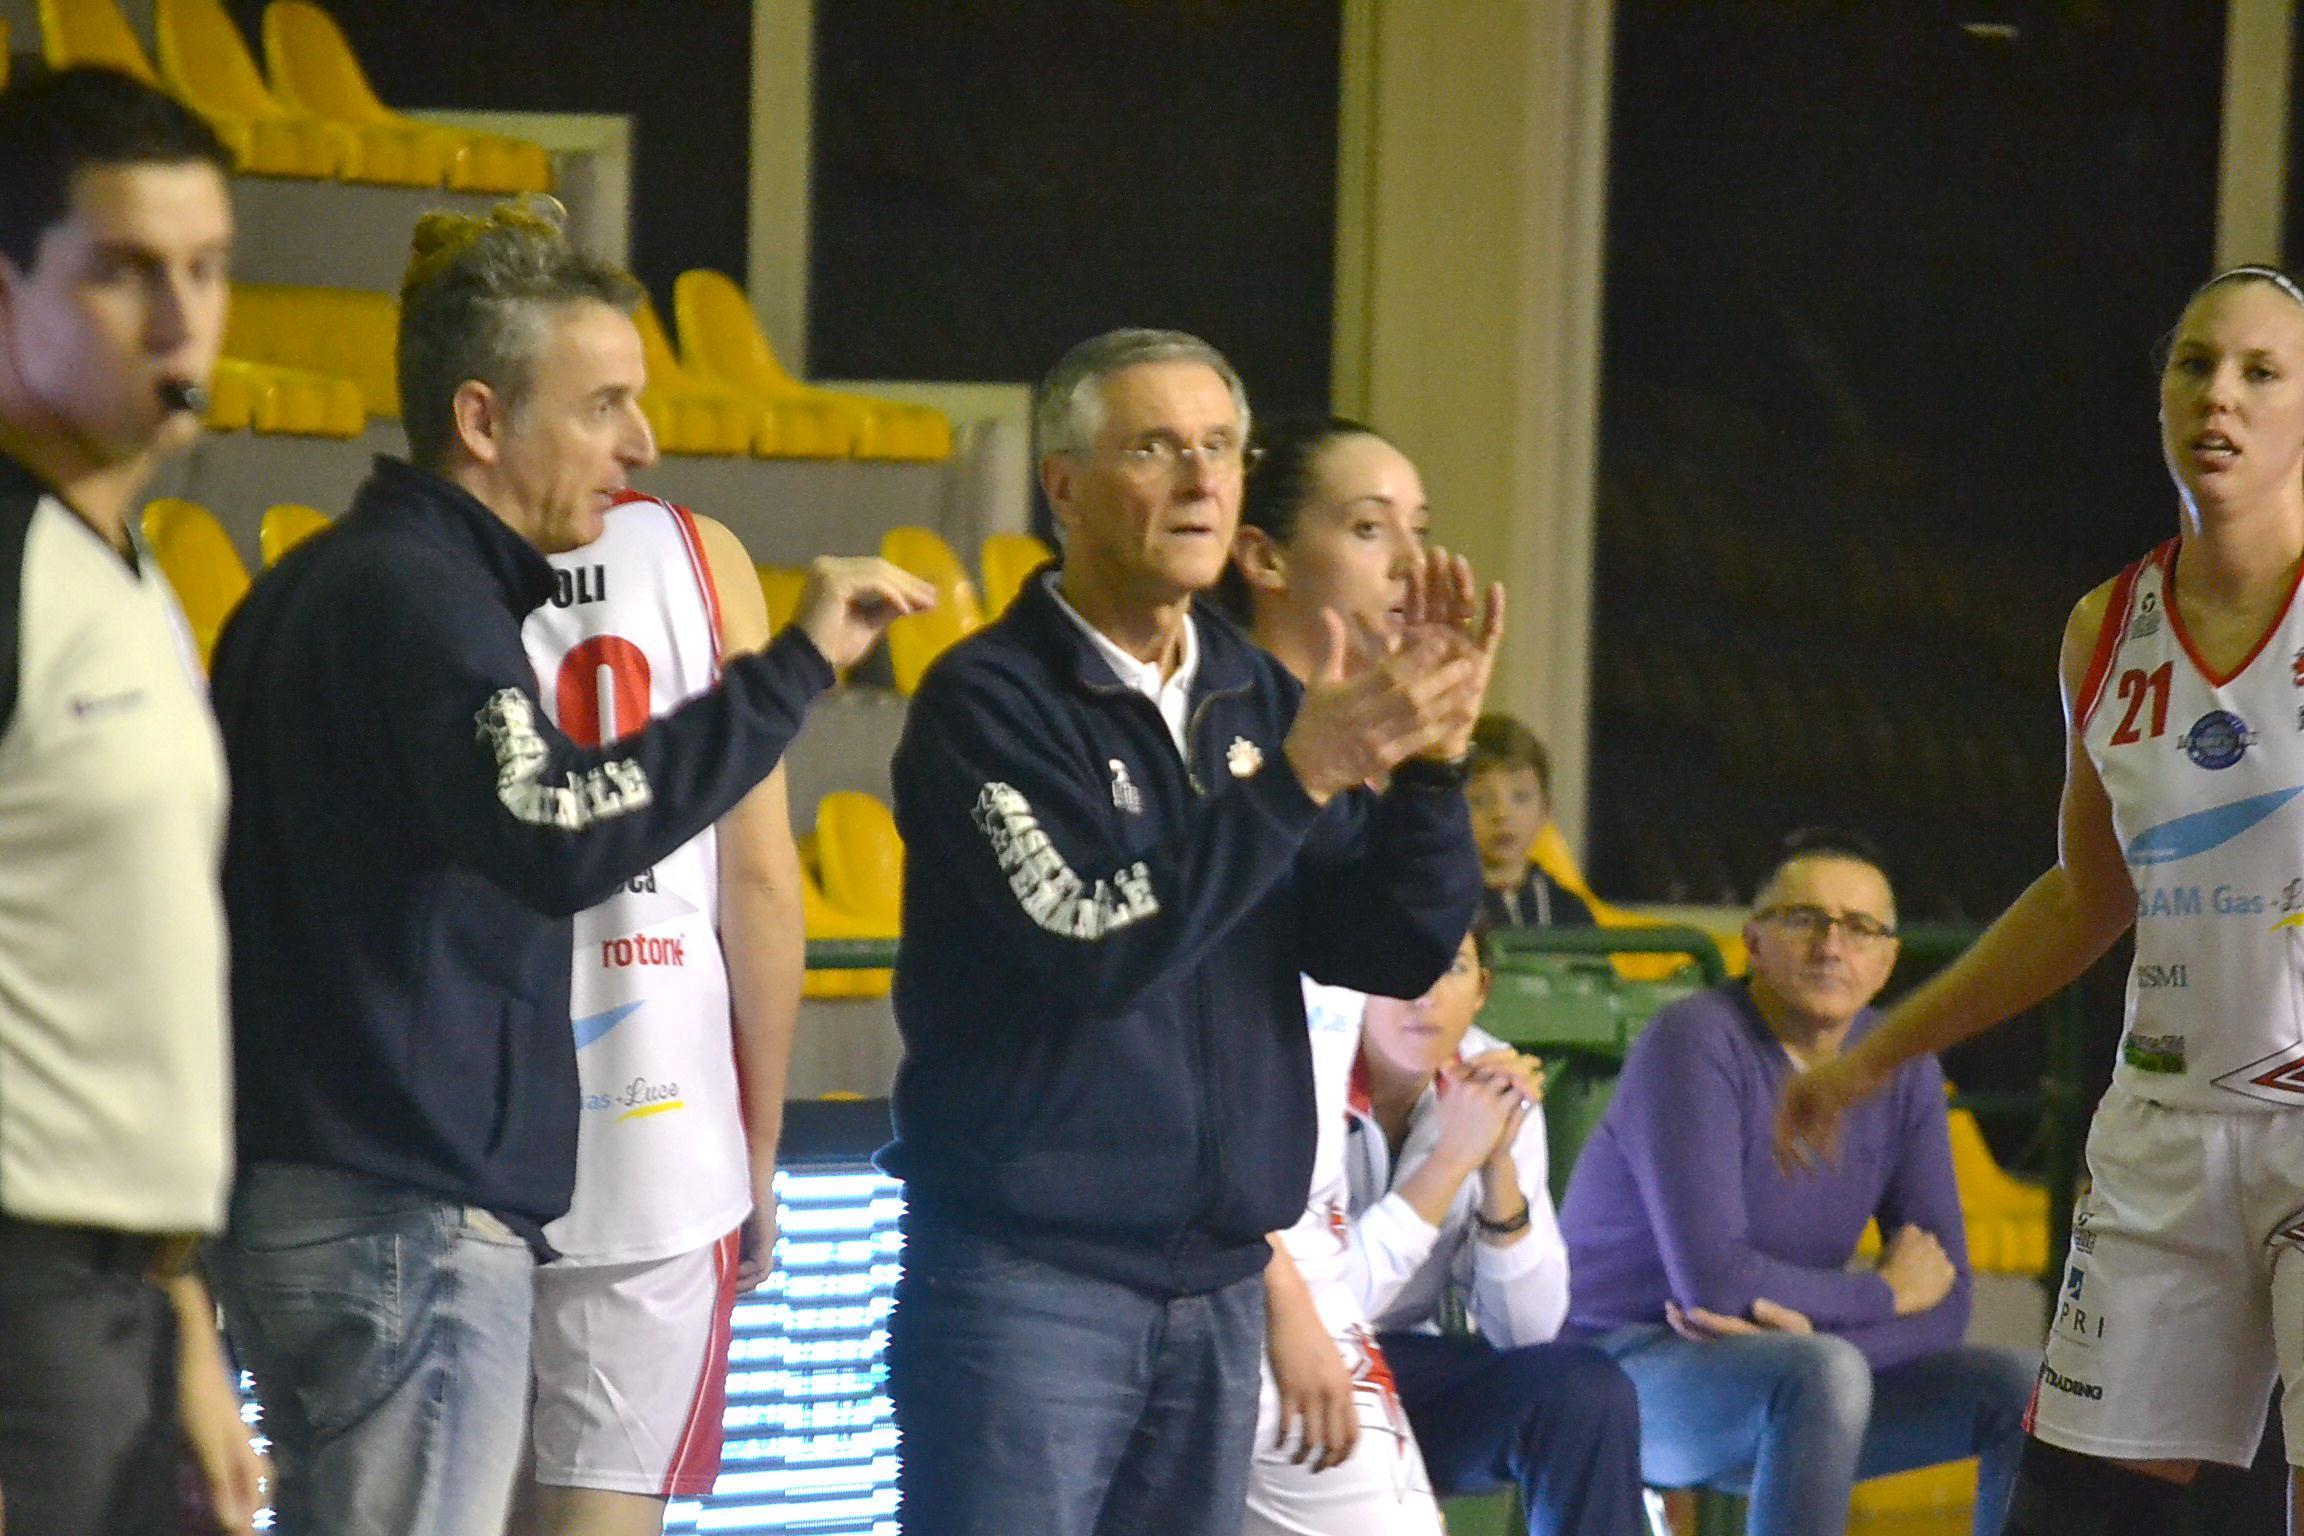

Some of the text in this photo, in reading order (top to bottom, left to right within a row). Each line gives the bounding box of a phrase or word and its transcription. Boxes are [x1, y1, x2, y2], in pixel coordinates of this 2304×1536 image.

[2109, 660, 2175, 747] 21
[2212, 884, 2264, 915] Gas
[580, 1093, 611, 1110] as
